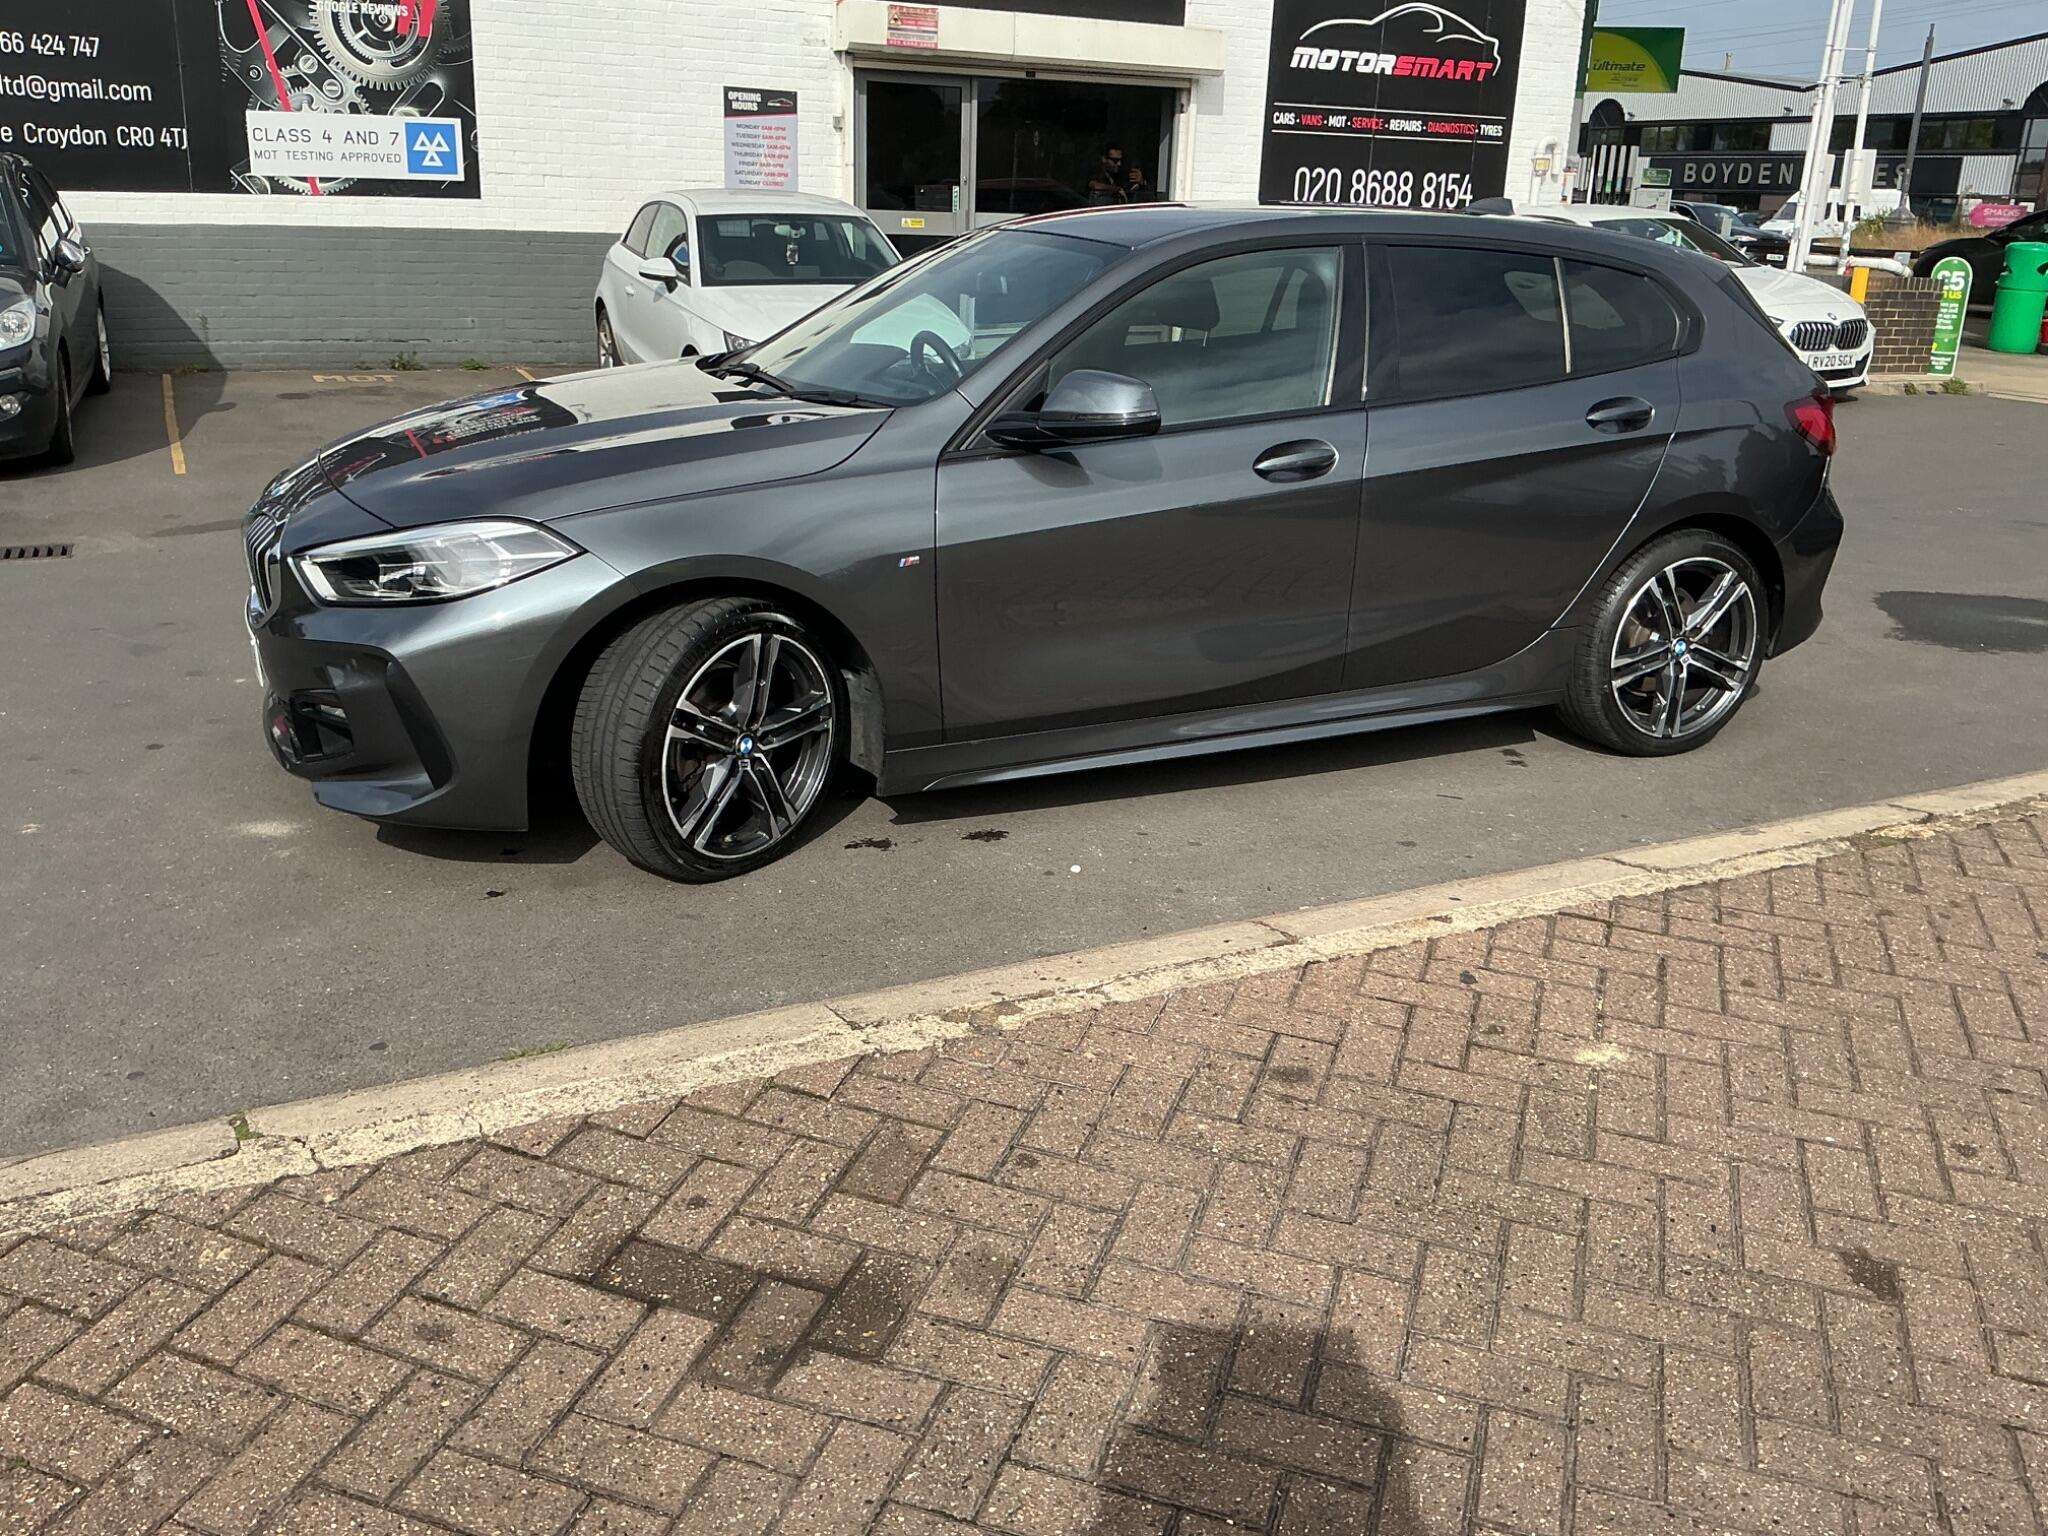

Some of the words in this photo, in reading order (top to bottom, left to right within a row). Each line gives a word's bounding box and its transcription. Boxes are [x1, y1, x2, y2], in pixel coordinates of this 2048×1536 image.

[316, 1, 359, 14] GOOGLE
[360, 4, 409, 17] REVIEWS
[30, 33, 65, 56] 424
[69, 35, 100, 58] 747
[1289, 46, 1496, 82] MOTORSMART
[727, 91, 762, 102] OPENING
[731, 101, 758, 111] HOURS
[1273, 112, 1295, 125] CARS
[1301, 113, 1323, 126] VANS
[1328, 115, 1347, 128] MOT
[1352, 116, 1384, 130] SERVICE
[1389, 119, 1423, 132] REPAIRS
[1427, 121, 1476, 135] DIAGNOSTICS
[1479, 124, 1503, 136] TYRES
[23, 122, 108, 149] Croydon
[160, 127, 188, 150] 4TJ
[252, 127, 312, 143] CLASS
[322, 129, 333, 144] 4
[344, 130, 379, 146] AND
[389, 132, 400, 146] 7
[254, 150, 278, 160] MOT
[286, 151, 334, 162] TESTING
[340, 152, 401, 163] APPROVED
[1682, 162, 1795, 185] BOYDEN
[1293, 166, 1342, 202] 020
[1350, 168, 1414, 207] 8688
[1420, 171, 1473, 210] 8154
[312, 374, 399, 384] MOT
